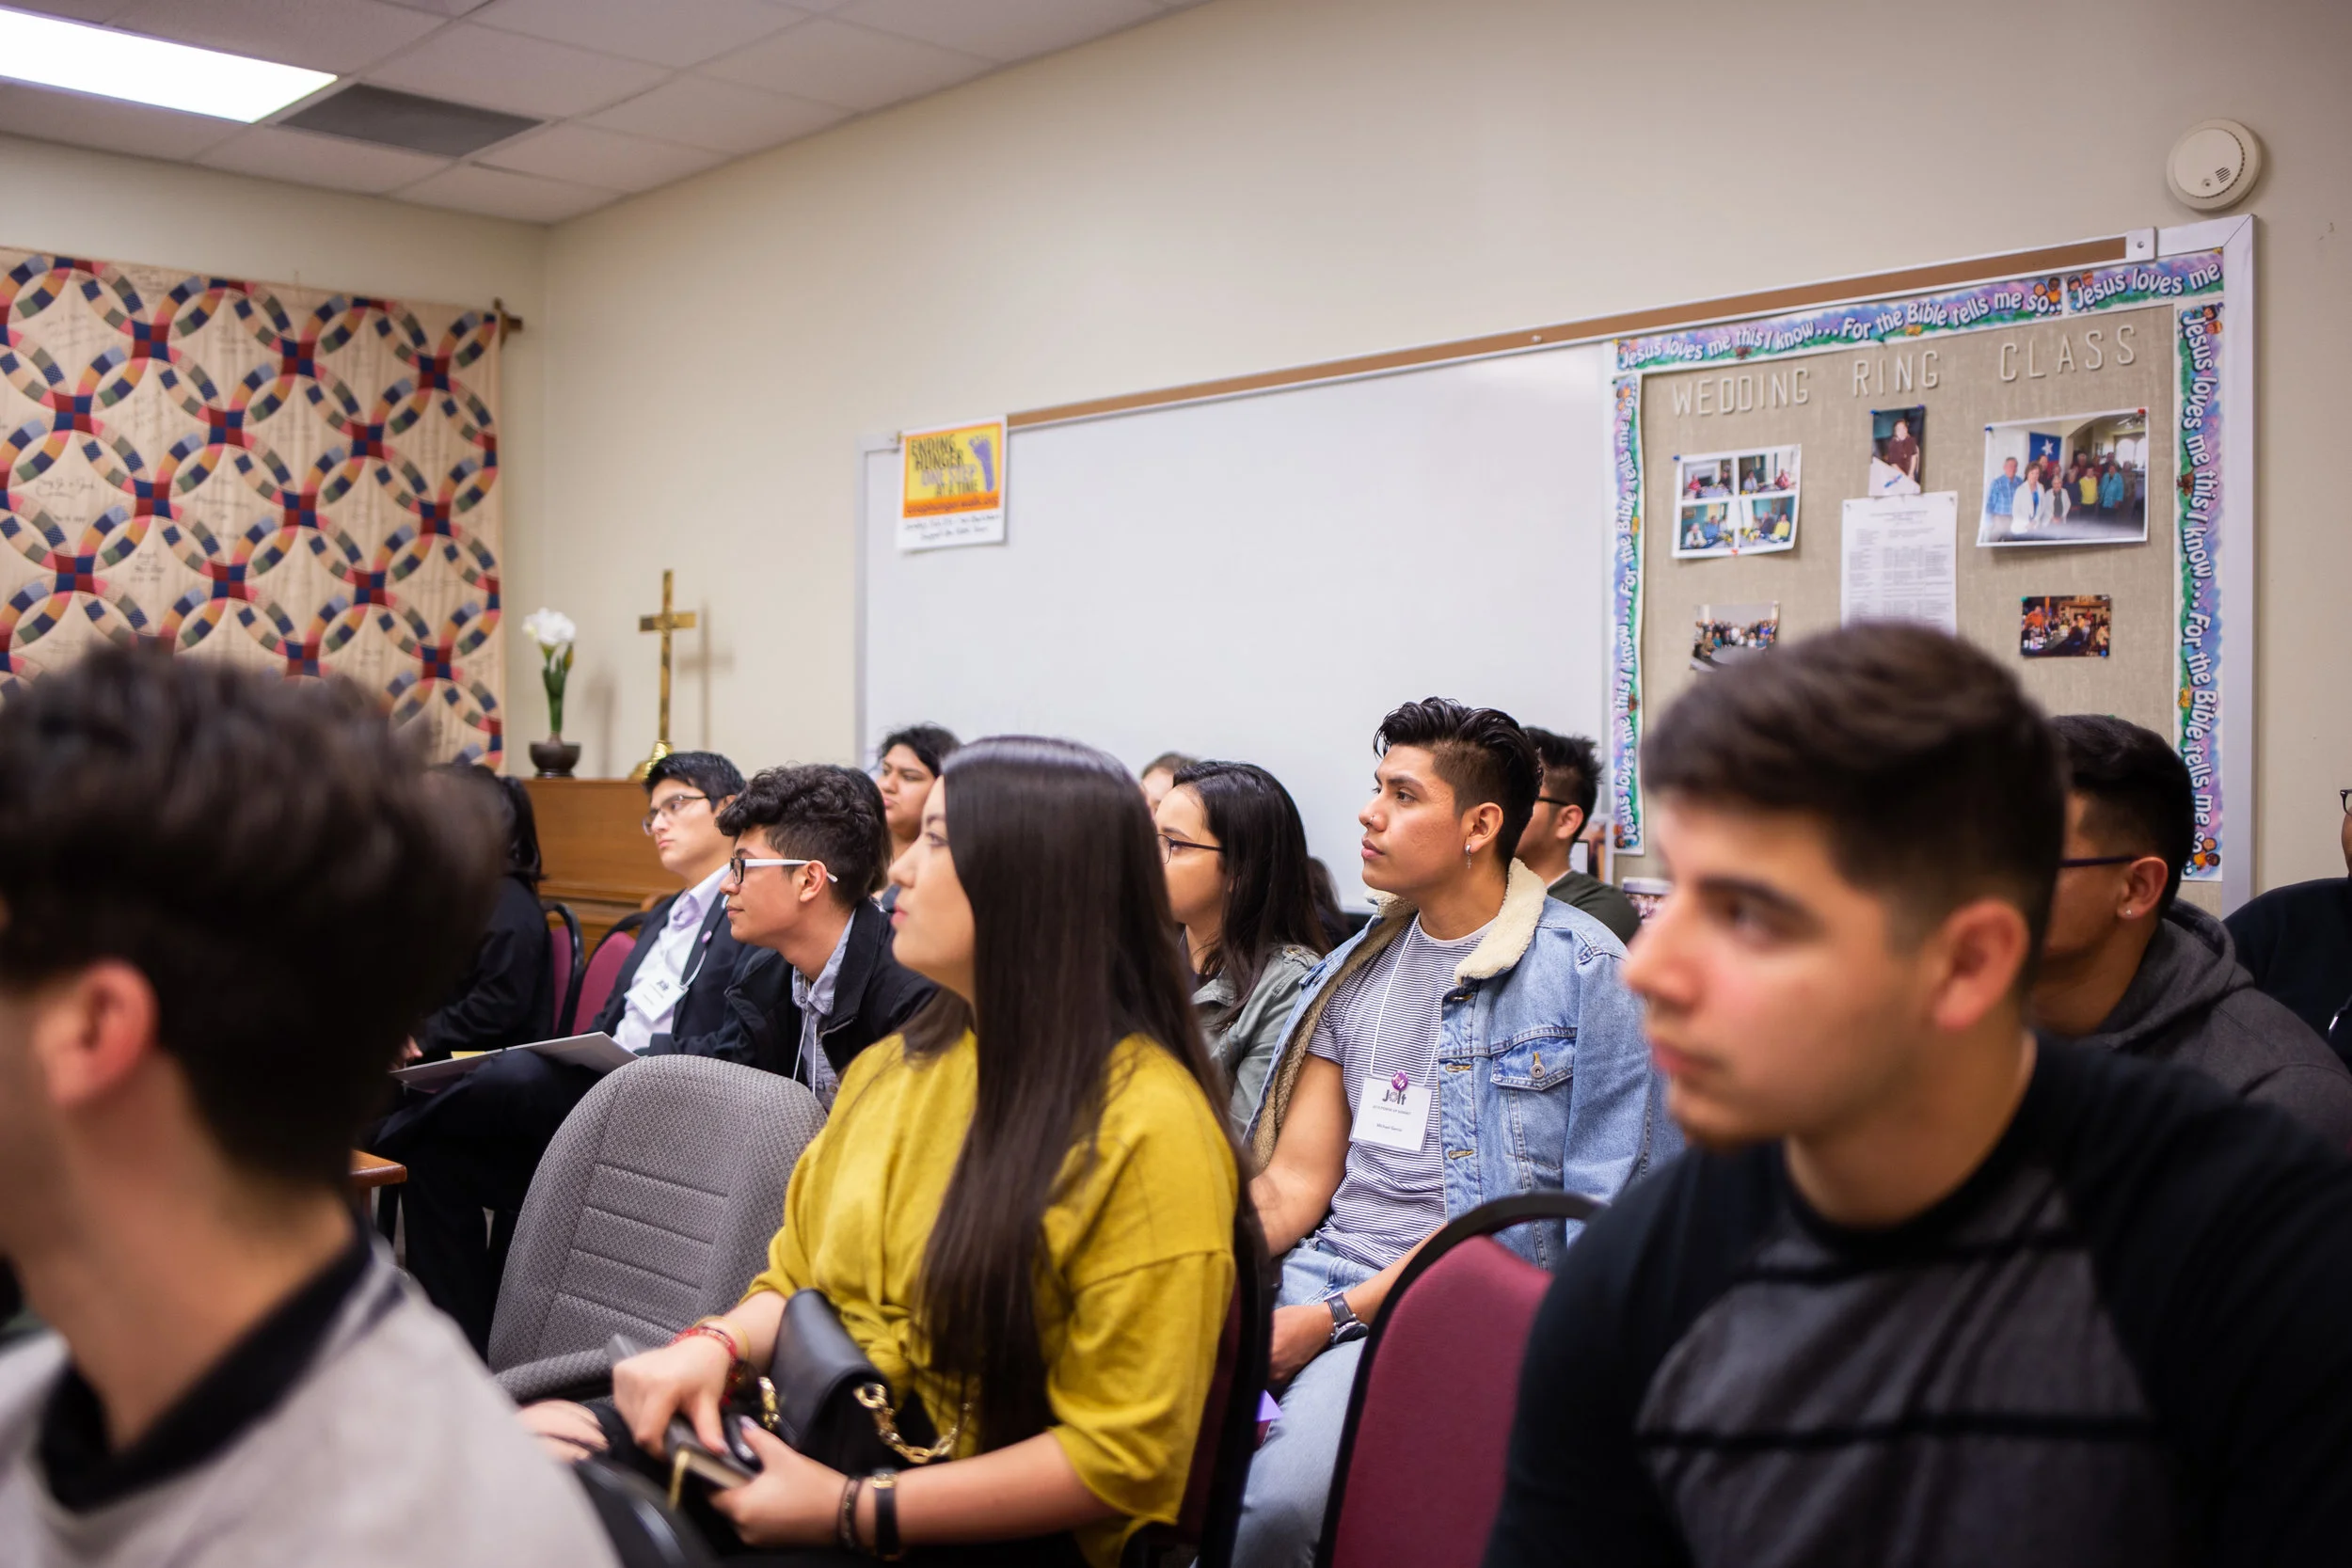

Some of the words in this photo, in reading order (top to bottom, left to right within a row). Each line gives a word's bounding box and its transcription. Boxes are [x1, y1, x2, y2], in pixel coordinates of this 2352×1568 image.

[2074, 273, 2126, 309] Jesus
[2132, 268, 2184, 294] loves
[2189, 262, 2221, 290] me
[1620, 341, 1661, 369] Jesus
[1666, 338, 1703, 359] loves
[1708, 336, 1732, 356] me
[1736, 328, 1763, 347] this
[1764, 330, 1774, 349] I
[1841, 318, 1872, 340] For
[1876, 310, 1903, 332] the
[1907, 303, 1948, 326] Bible
[1952, 298, 1991, 327] tells
[1994, 292, 2023, 309] me
[2184, 316, 2214, 372] Jesus
[1672, 368, 1810, 419] WEDDING
[1852, 350, 1940, 399] RING
[1999, 325, 2136, 382] CLASS
[2183, 375, 2217, 430] loves
[1618, 420, 1630, 447] me
[2185, 433, 2210, 467] me
[1618, 450, 1639, 485] tells
[2190, 469, 2217, 510] this
[1616, 490, 1637, 531] Bible
[2185, 511, 2209, 525] I
[1619, 533, 1635, 564] the
[1618, 567, 1638, 597] For
[2183, 612, 2211, 648] For
[2185, 651, 2212, 686] the
[1615, 679, 1630, 712] this
[1619, 715, 1634, 744] me
[2185, 689, 2217, 741] Bible
[1616, 747, 1635, 792] loves
[2184, 745, 2211, 789] tells
[1618, 795, 1638, 843] Jesus
[2194, 794, 2213, 827] me
